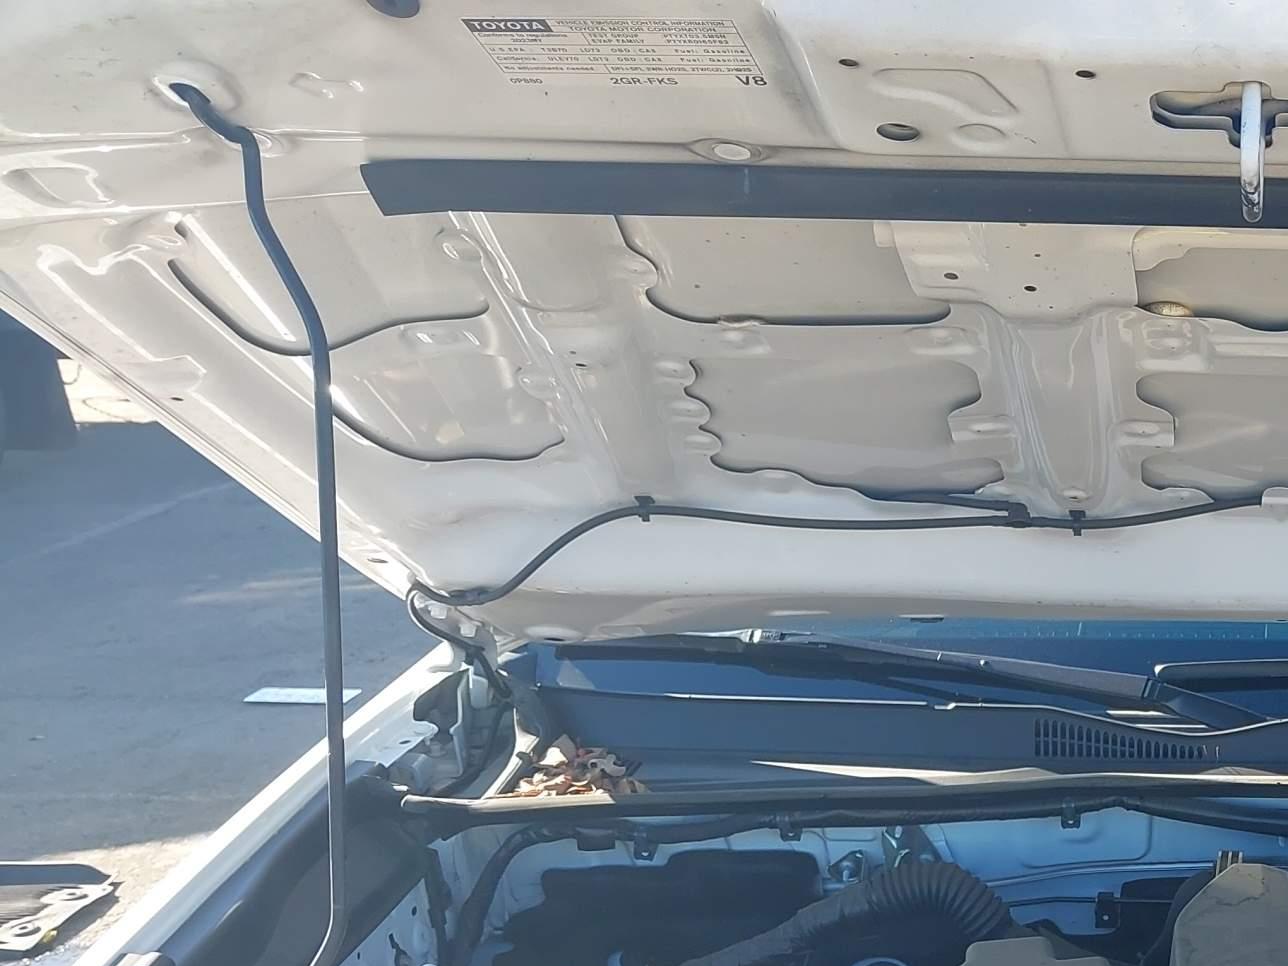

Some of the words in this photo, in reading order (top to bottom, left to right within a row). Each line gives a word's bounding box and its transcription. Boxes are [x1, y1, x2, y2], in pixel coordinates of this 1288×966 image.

[470, 21, 545, 30] TOYOTA
[609, 77, 679, 85] 2GR-FKS
[736, 75, 768, 86] V8
